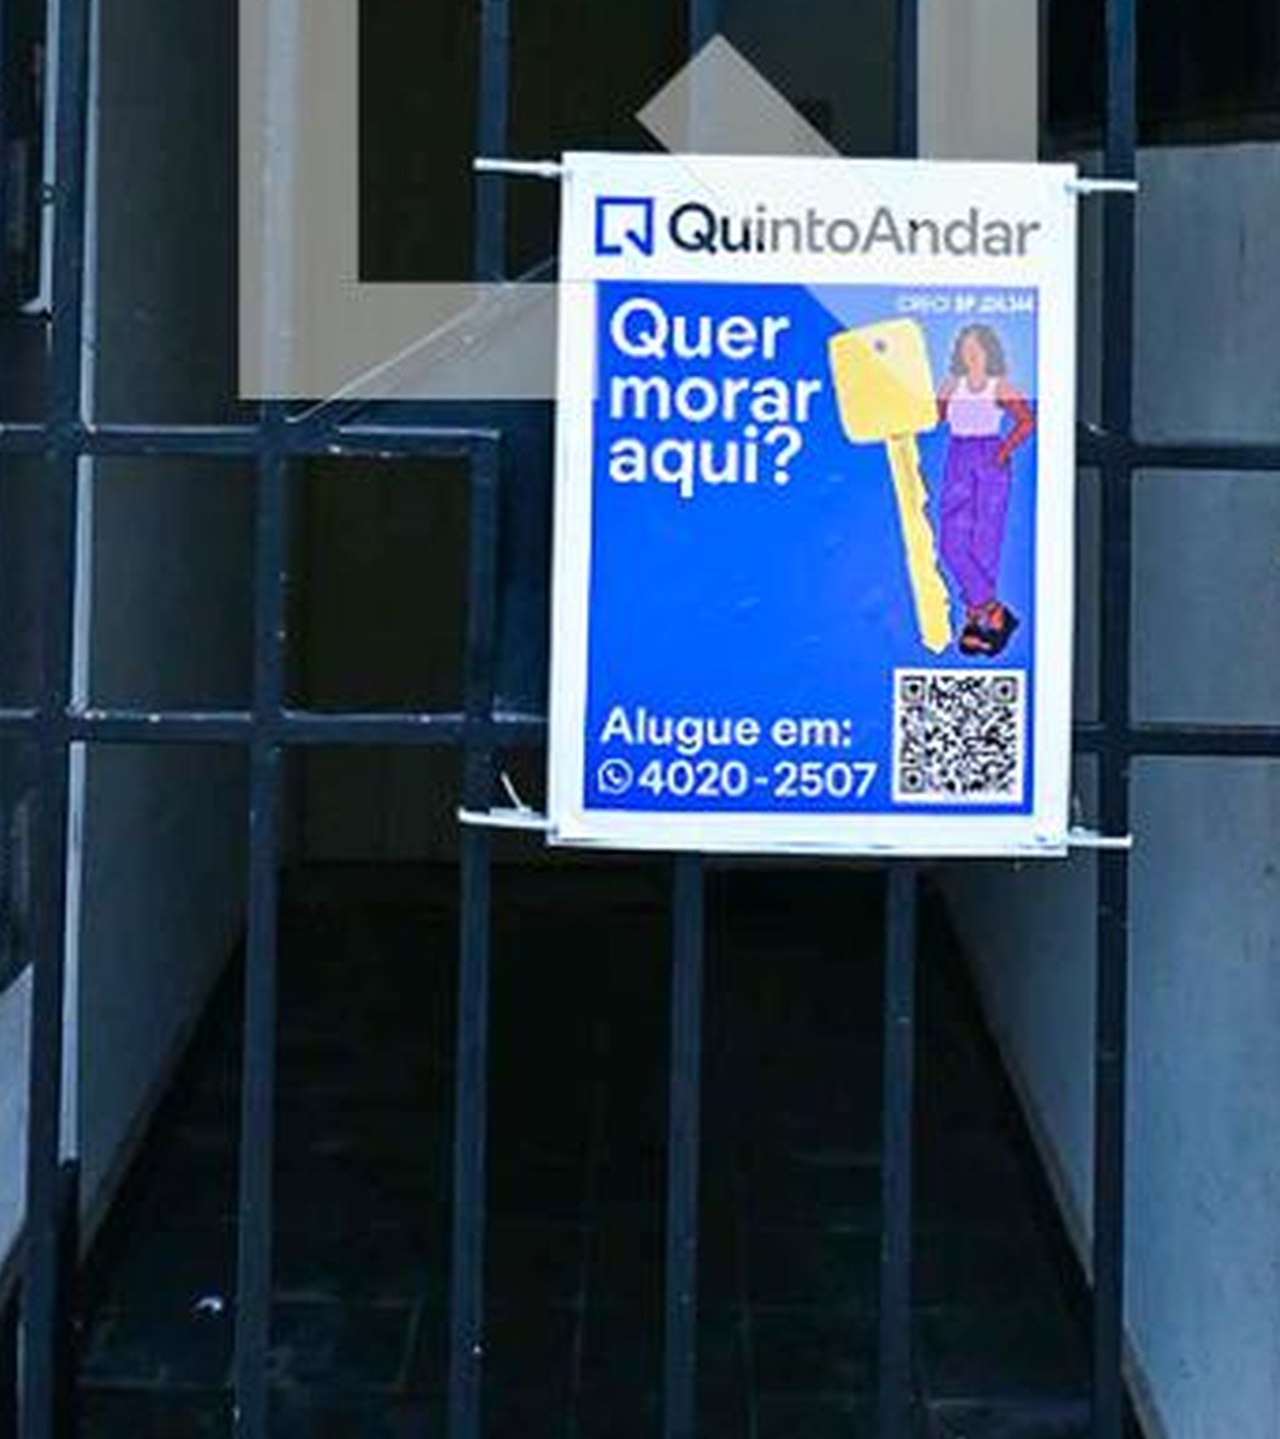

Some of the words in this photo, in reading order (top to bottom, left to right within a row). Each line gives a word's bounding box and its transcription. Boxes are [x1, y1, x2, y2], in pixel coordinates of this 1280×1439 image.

[668, 201, 1041, 257] QuintoAndar
[609, 296, 791, 360] Quer
[609, 374, 822, 423] morar
[608, 425, 803, 498] aqui?
[600, 706, 761, 755] Alugue
[771, 715, 853, 748] em:
